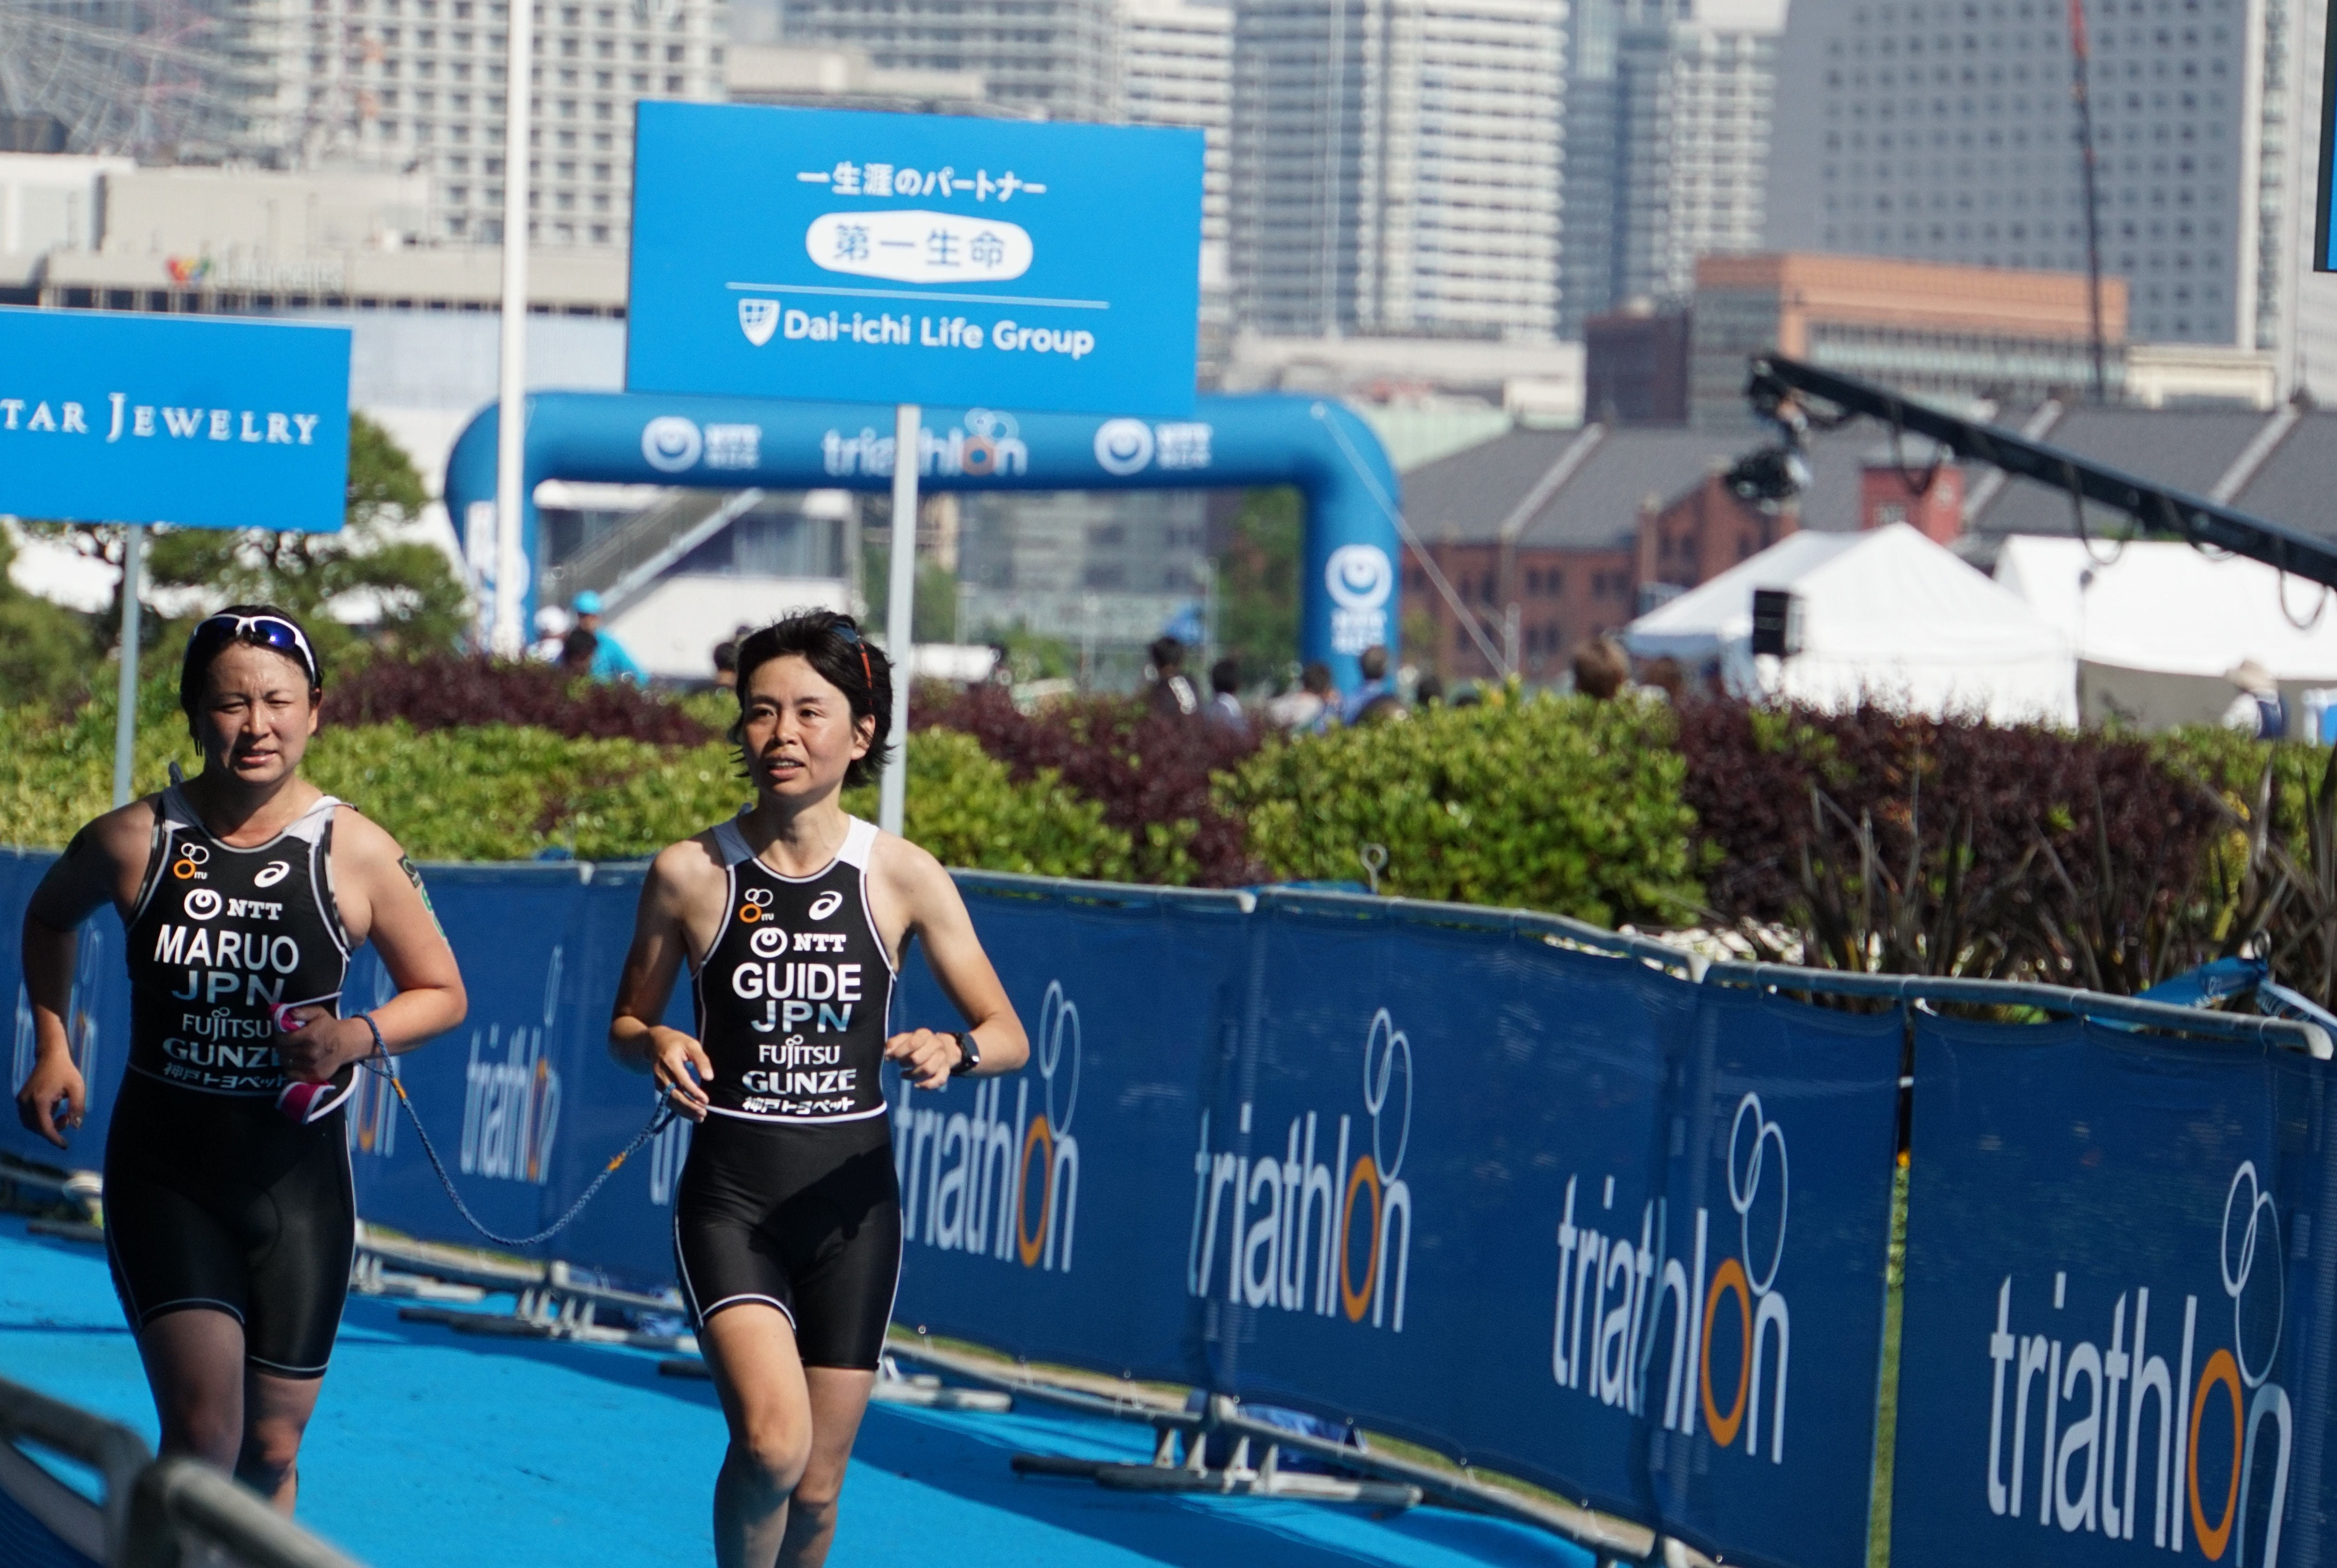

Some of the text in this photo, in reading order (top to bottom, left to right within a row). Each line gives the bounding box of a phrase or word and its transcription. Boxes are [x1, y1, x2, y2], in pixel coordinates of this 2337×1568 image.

[796, 161, 1047, 202] 一生涯のパートナー
[834, 224, 1006, 268] 第一生命
[784, 308, 1095, 361] Dai-ichi Life Group
[194, 871, 208, 879] ITU
[227, 899, 282, 920] NTT
[153, 925, 299, 974] MARUO
[793, 934, 846, 951] NTT
[172, 970, 284, 1006] JPN
[732, 963, 861, 1001] GUIDE
[182, 1007, 272, 1041] FUJITSU
[750, 1000, 852, 1032] JPN
[759, 1035, 840, 1069] FUJITSU
[742, 1069, 857, 1095] GUNZE
[894, 1076, 1080, 1273] triathlon
[1187, 1101, 1412, 1333] triathlon
[1553, 1172, 1790, 1465] triathlon
[1988, 1270, 2293, 1568] triathlon
